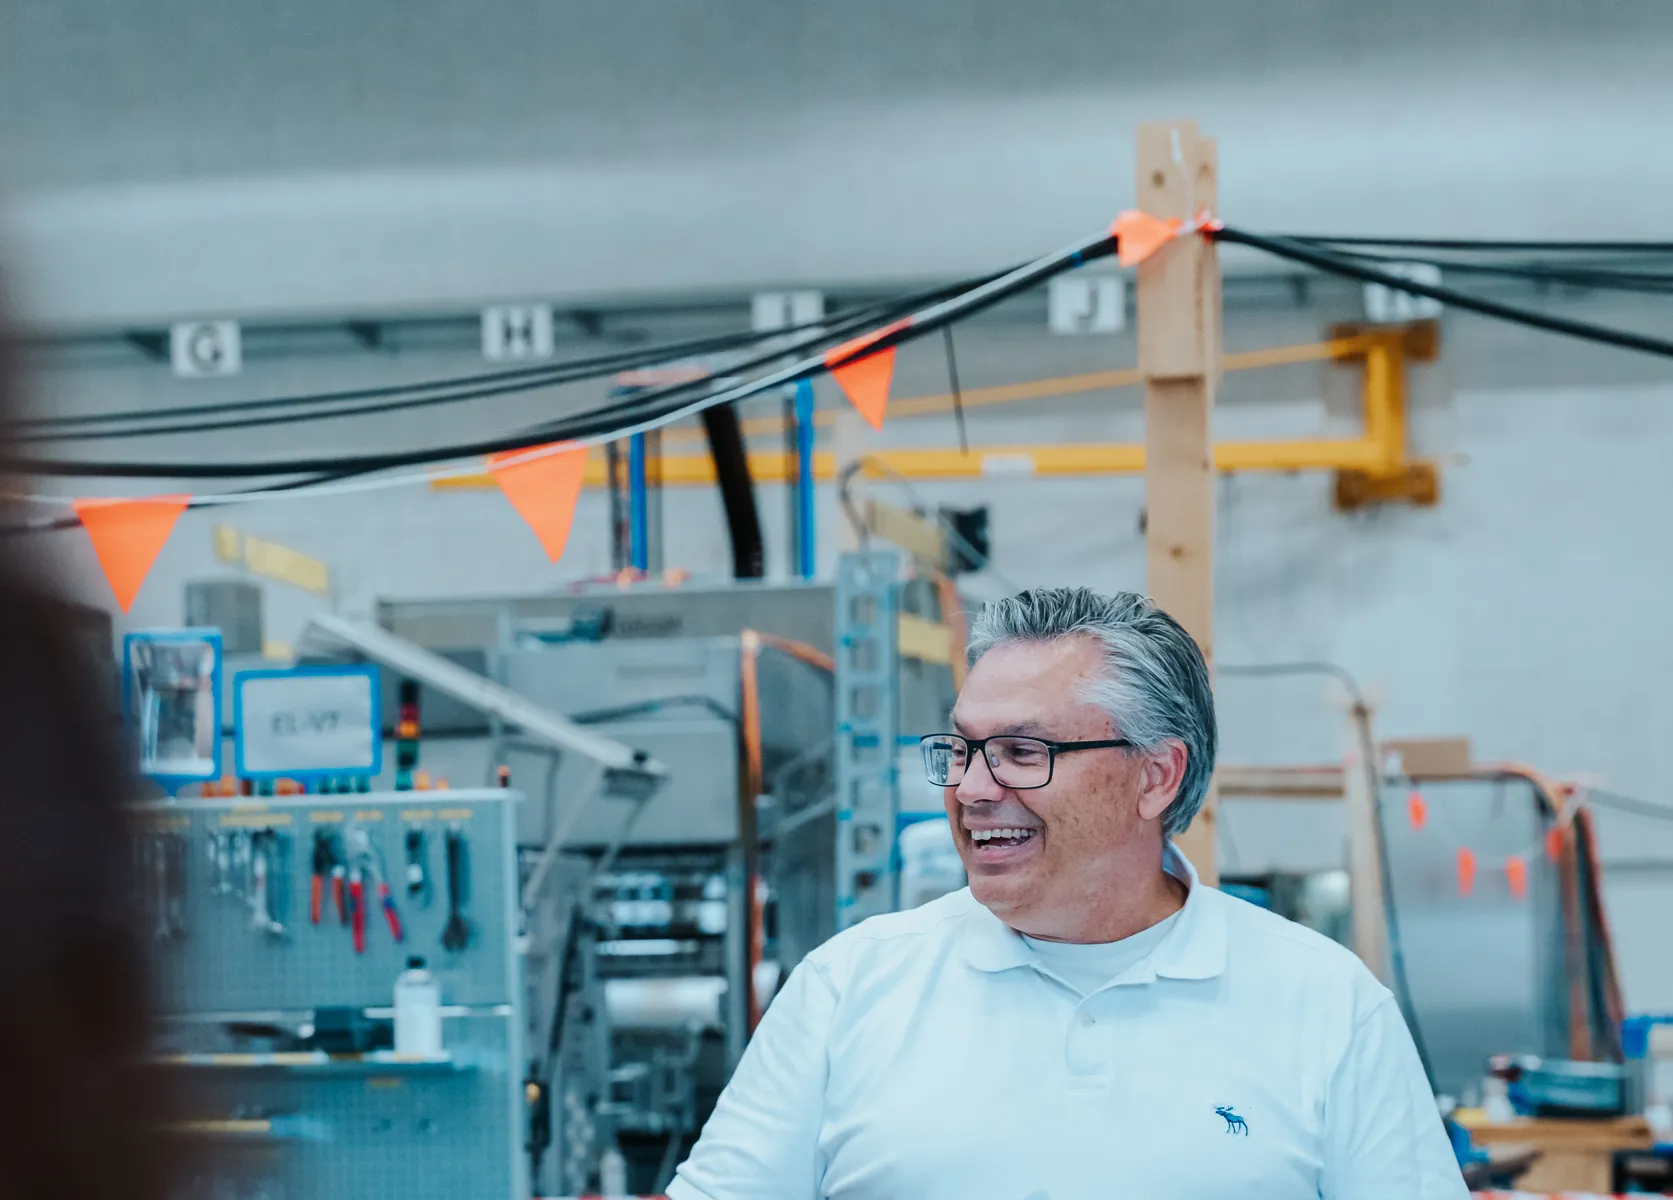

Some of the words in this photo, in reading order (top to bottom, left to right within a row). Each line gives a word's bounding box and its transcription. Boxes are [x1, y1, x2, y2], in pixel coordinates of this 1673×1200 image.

[502, 306, 533, 357] H
[1073, 278, 1100, 333] J
[187, 322, 223, 374] G
